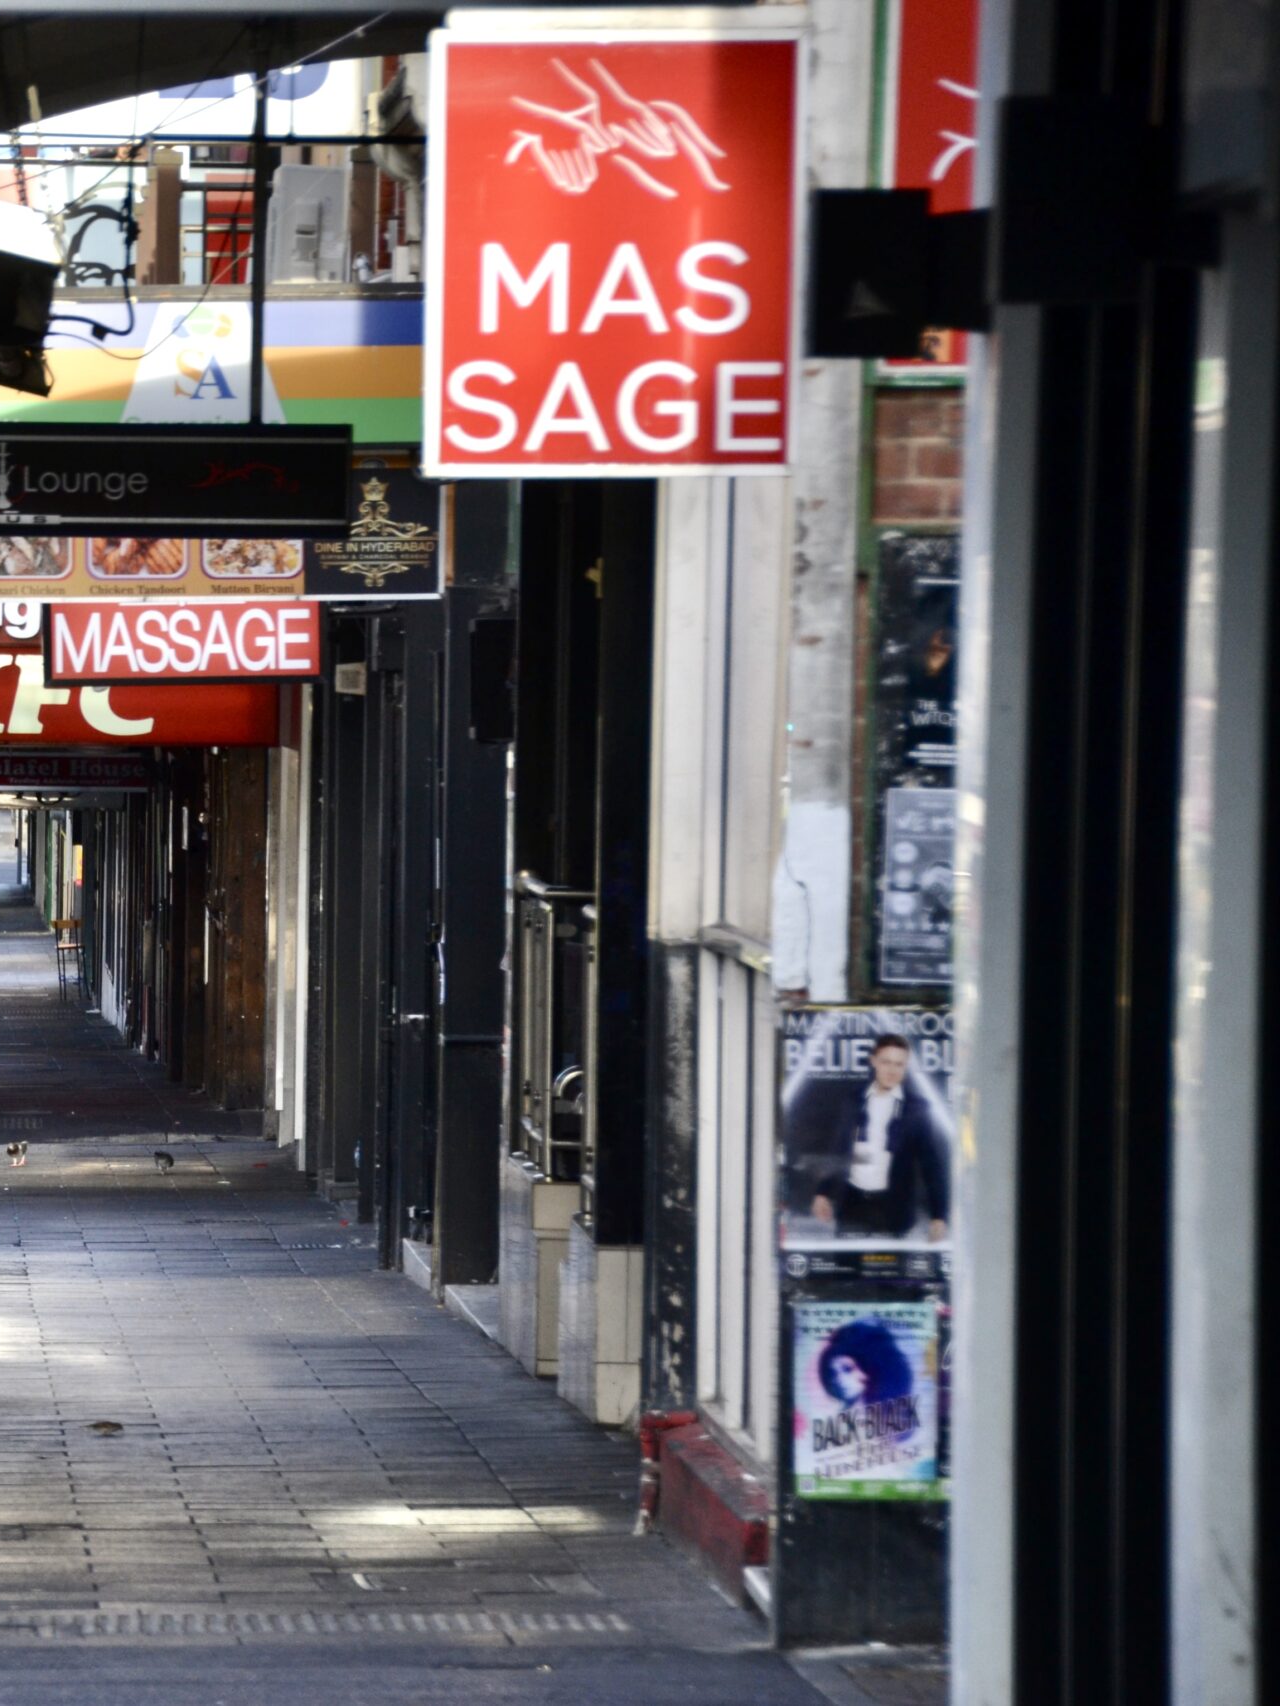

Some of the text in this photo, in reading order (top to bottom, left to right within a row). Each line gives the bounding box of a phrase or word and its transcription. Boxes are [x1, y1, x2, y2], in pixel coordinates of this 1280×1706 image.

[478, 241, 751, 337] MAS
[443, 359, 784, 455] SAGE
[23, 465, 149, 500] Lounge
[314, 542, 435, 553] DINE IN HYDERABAD
[20, 584, 66, 596] Chicken
[88, 584, 186, 596] Chicken Tandoori
[211, 583, 295, 597] Mutton Biryani
[53, 607, 312, 675] MASSAGE
[70, 757, 146, 778] House
[785, 1012, 881, 1036] MARTIN
[812, 1404, 861, 1453] BACK
[864, 1394, 922, 1440] BLACK
